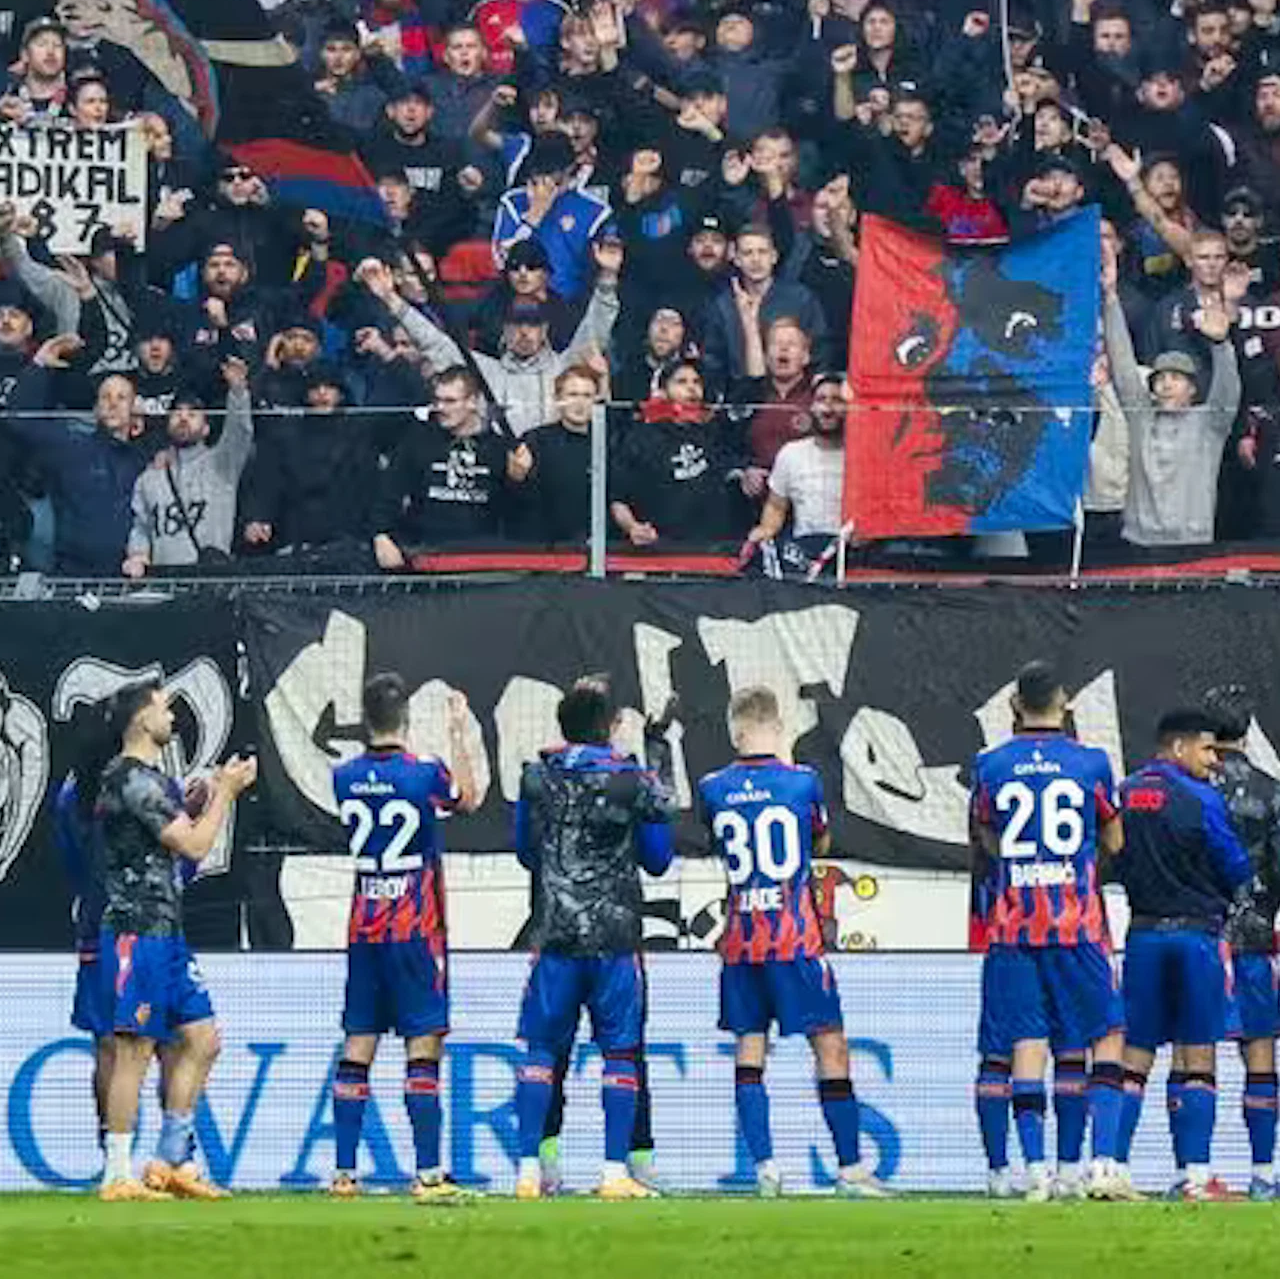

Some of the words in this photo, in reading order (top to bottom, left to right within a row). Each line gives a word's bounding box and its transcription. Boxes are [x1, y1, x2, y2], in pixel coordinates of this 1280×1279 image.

[340, 799, 423, 871] 22
[713, 805, 801, 885] 30
[995, 779, 1085, 858] 26
